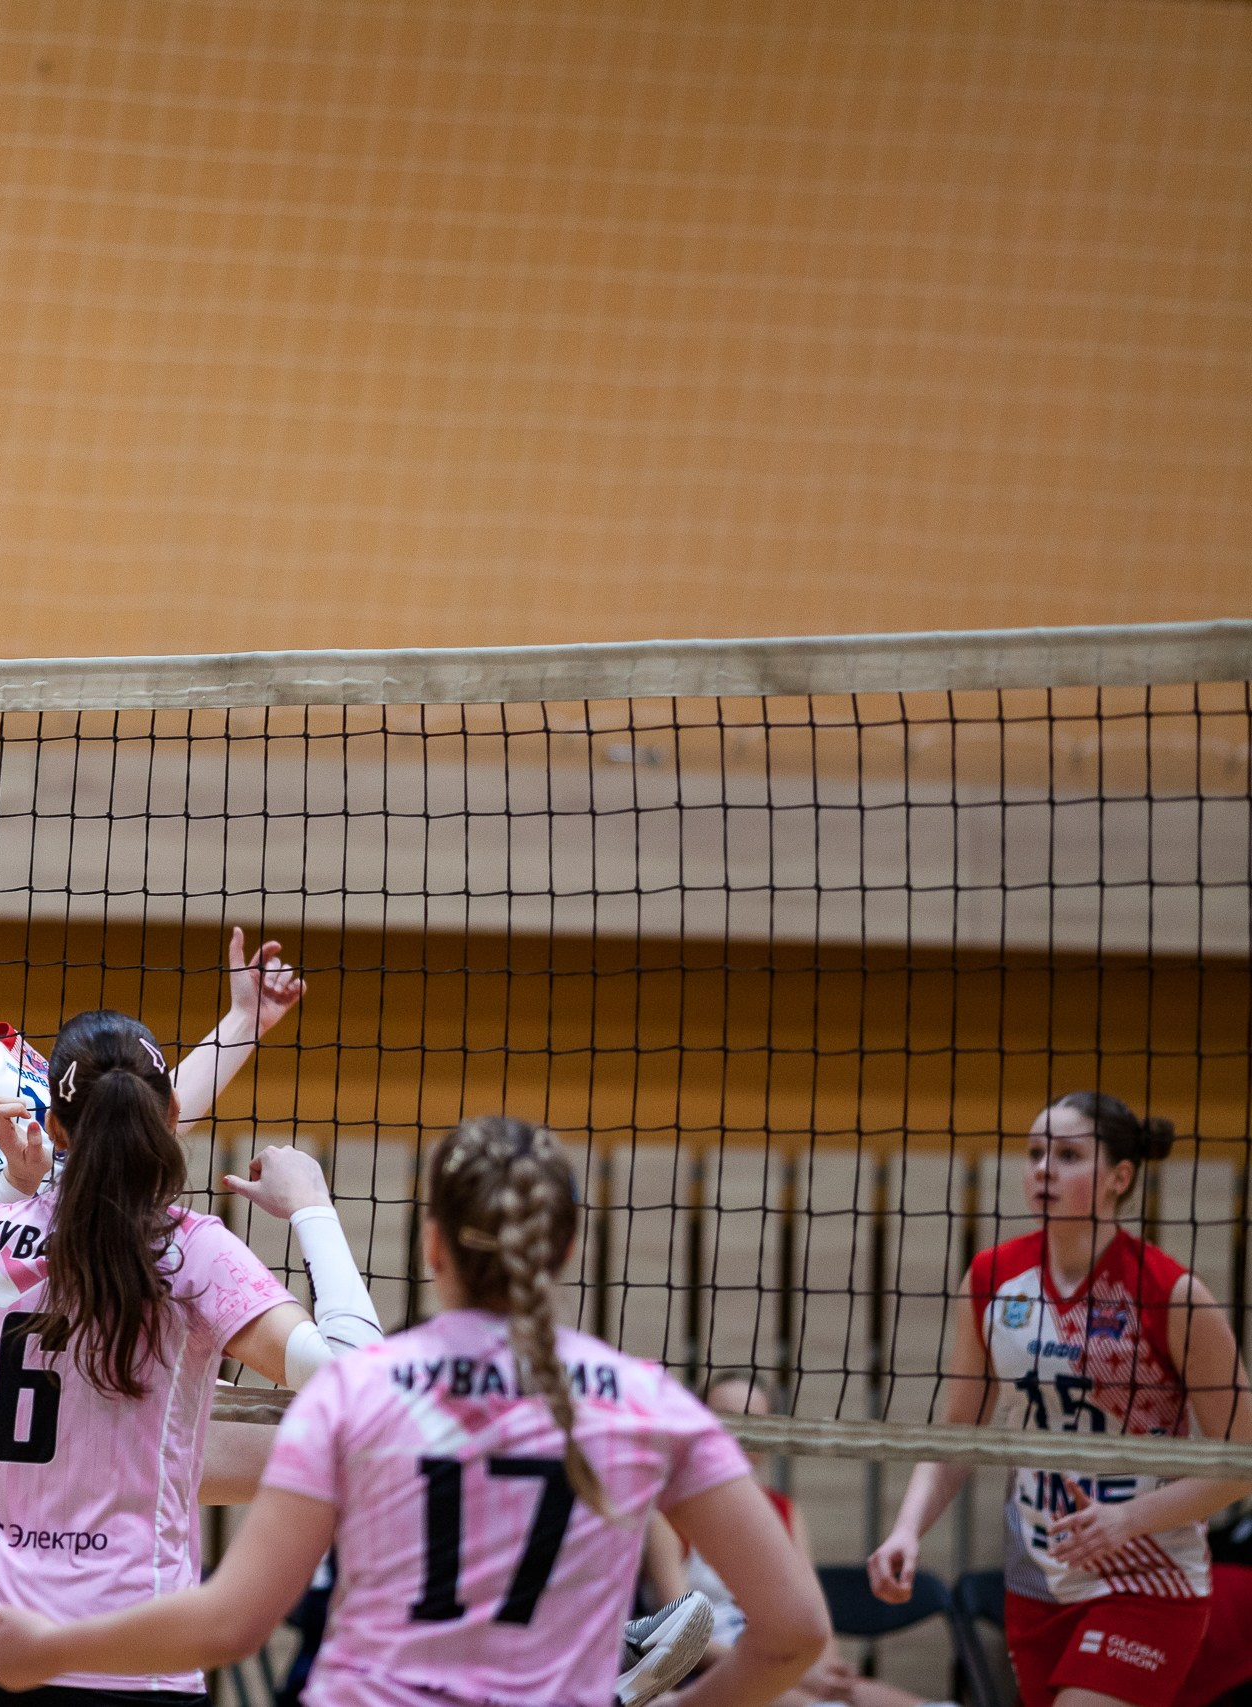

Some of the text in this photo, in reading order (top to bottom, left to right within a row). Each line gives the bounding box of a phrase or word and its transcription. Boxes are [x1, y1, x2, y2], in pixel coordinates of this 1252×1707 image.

[1016, 1370, 1106, 1432] 15
[8, 1524, 108, 1555] Электро
[409, 1457, 575, 1626] 17
[1106, 1646, 1159, 1672] VISION
[1107, 1634, 1167, 1664] GLOBAL
